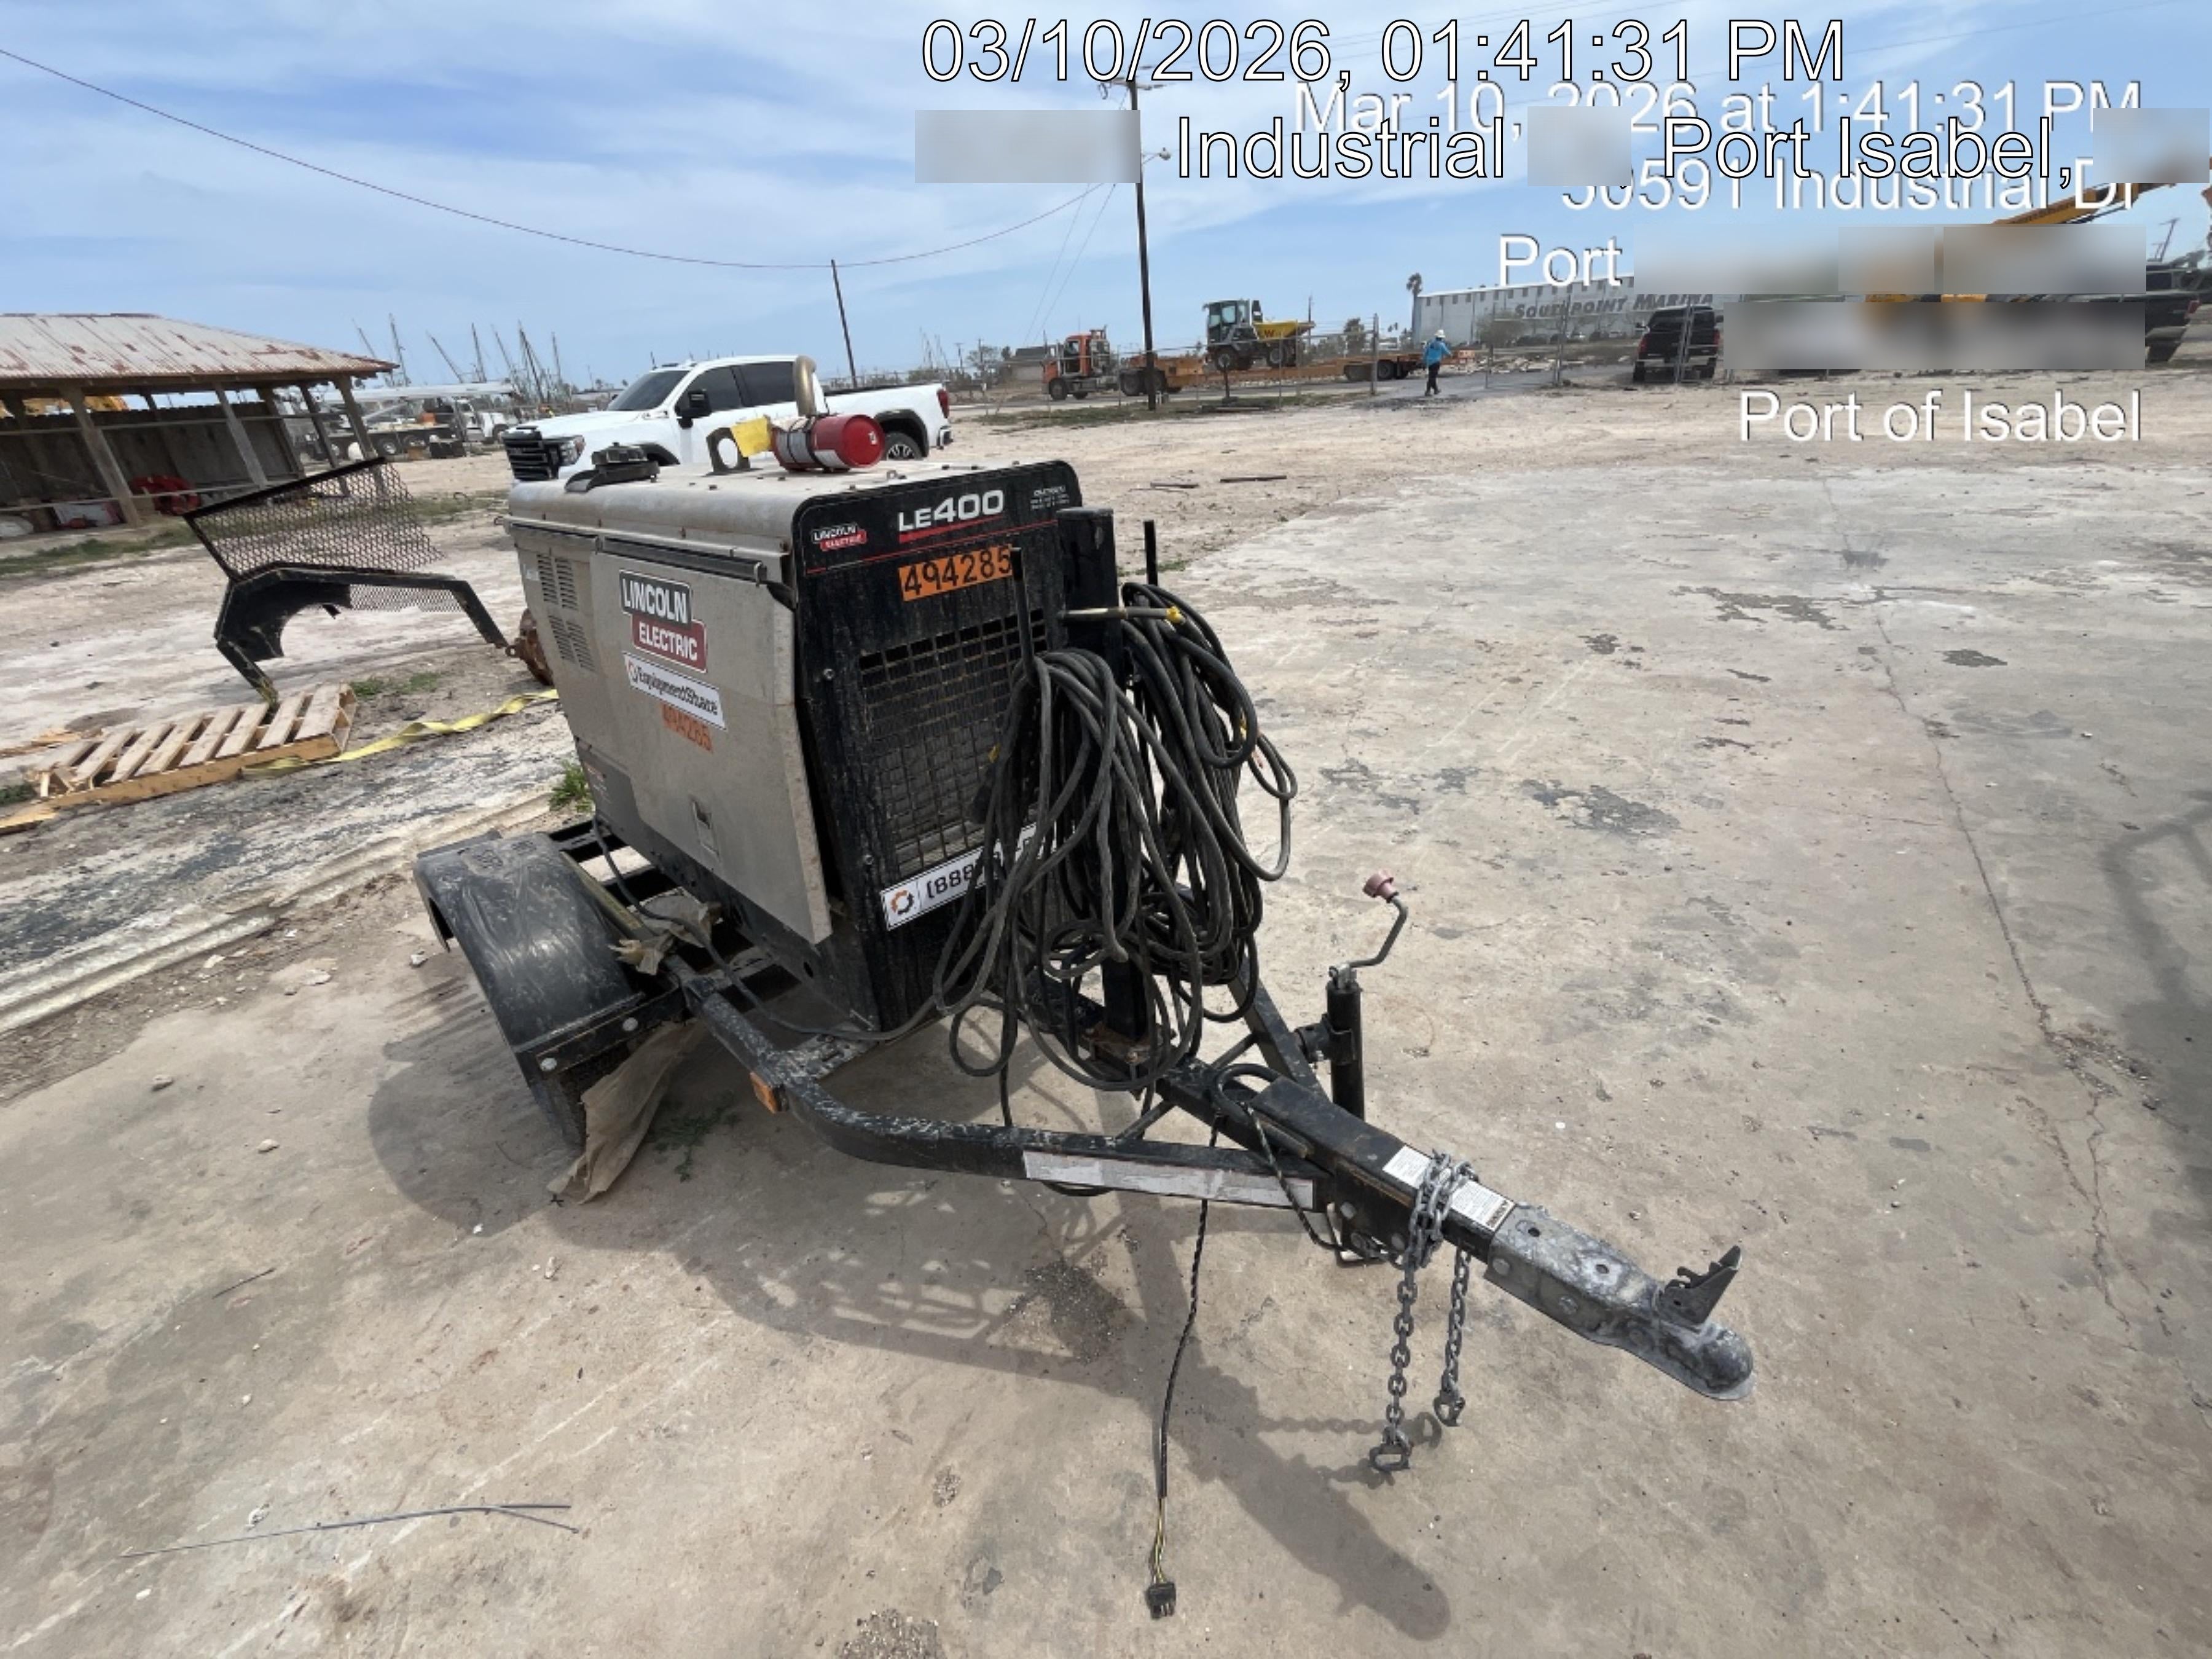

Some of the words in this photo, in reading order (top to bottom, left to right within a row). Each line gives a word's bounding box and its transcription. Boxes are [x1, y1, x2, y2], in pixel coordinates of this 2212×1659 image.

[898, 489, 1005, 531] LE400
[904, 546, 1012, 596] 494285
[622, 578, 688, 624] LINCOLN
[638, 621, 698, 662] ELECTRIC
